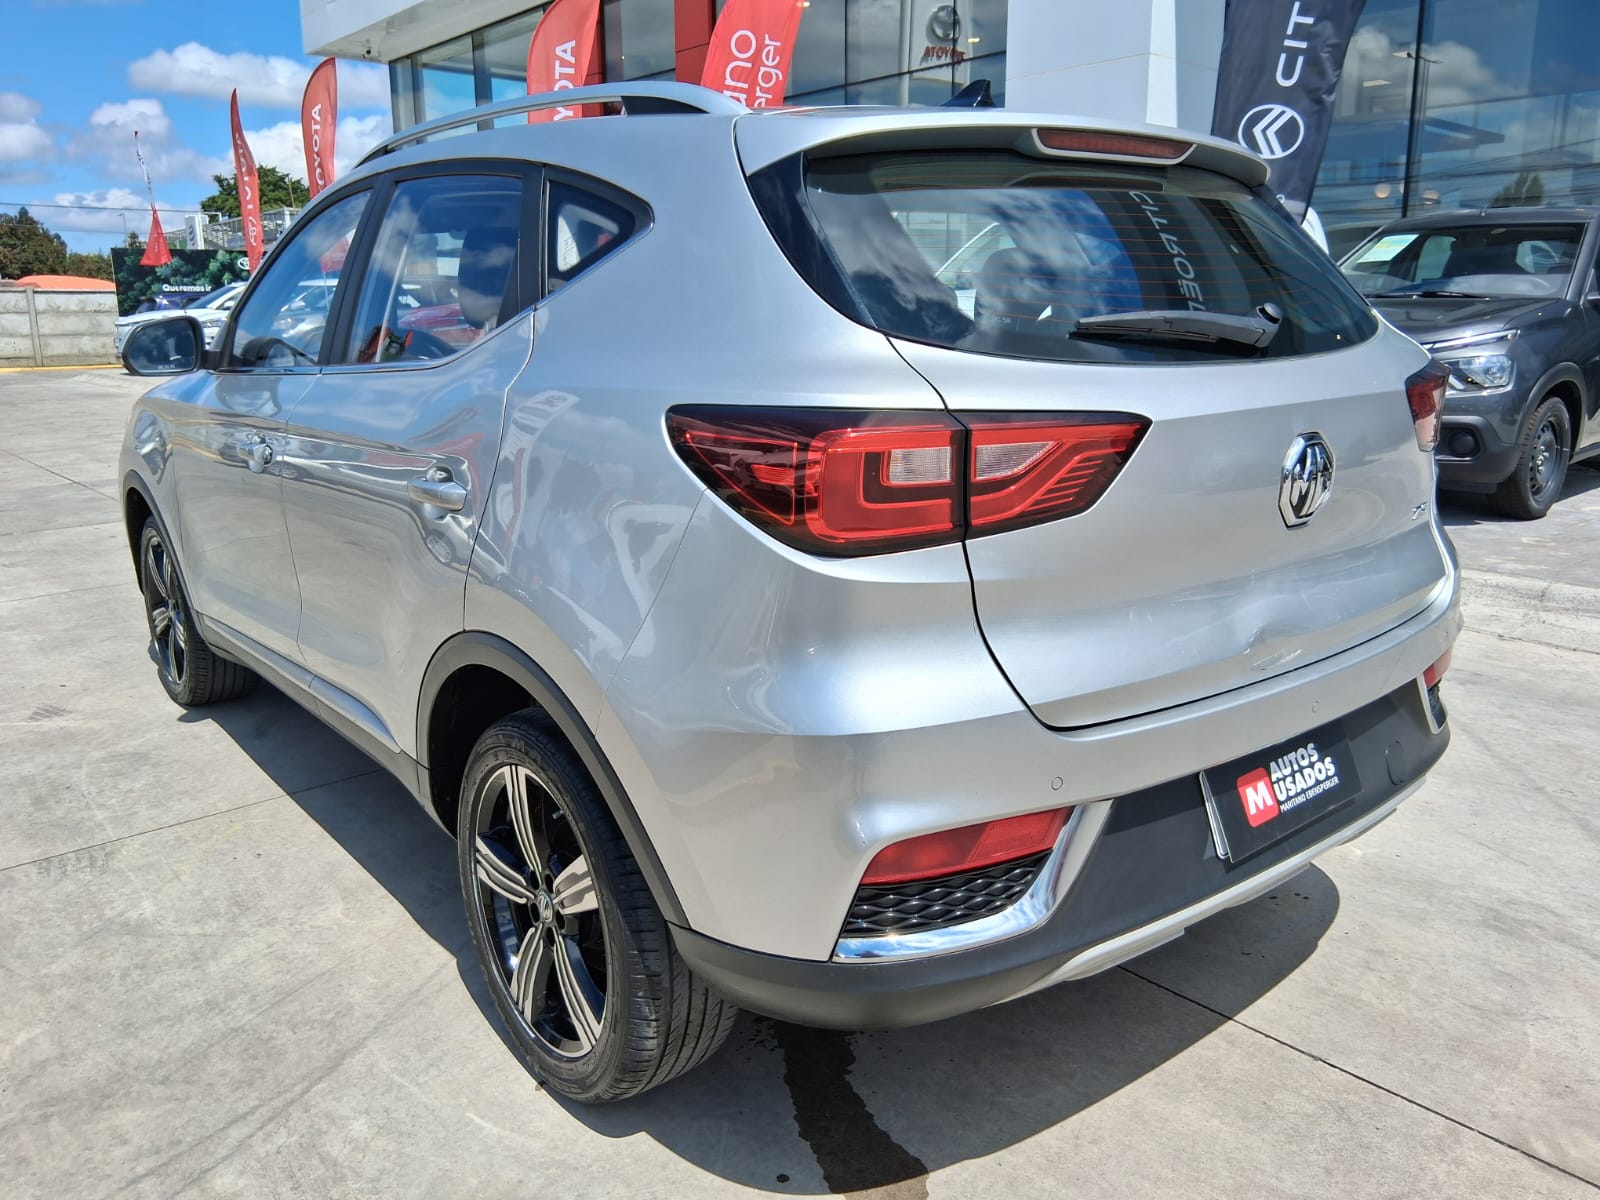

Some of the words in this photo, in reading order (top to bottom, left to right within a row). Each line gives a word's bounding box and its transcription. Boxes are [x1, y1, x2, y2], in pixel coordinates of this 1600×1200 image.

[311, 103, 325, 193] OYOTA
[1269, 742, 1319, 783] AUTOS
[1273, 757, 1336, 801] USADOS
[1245, 781, 1274, 815] M
